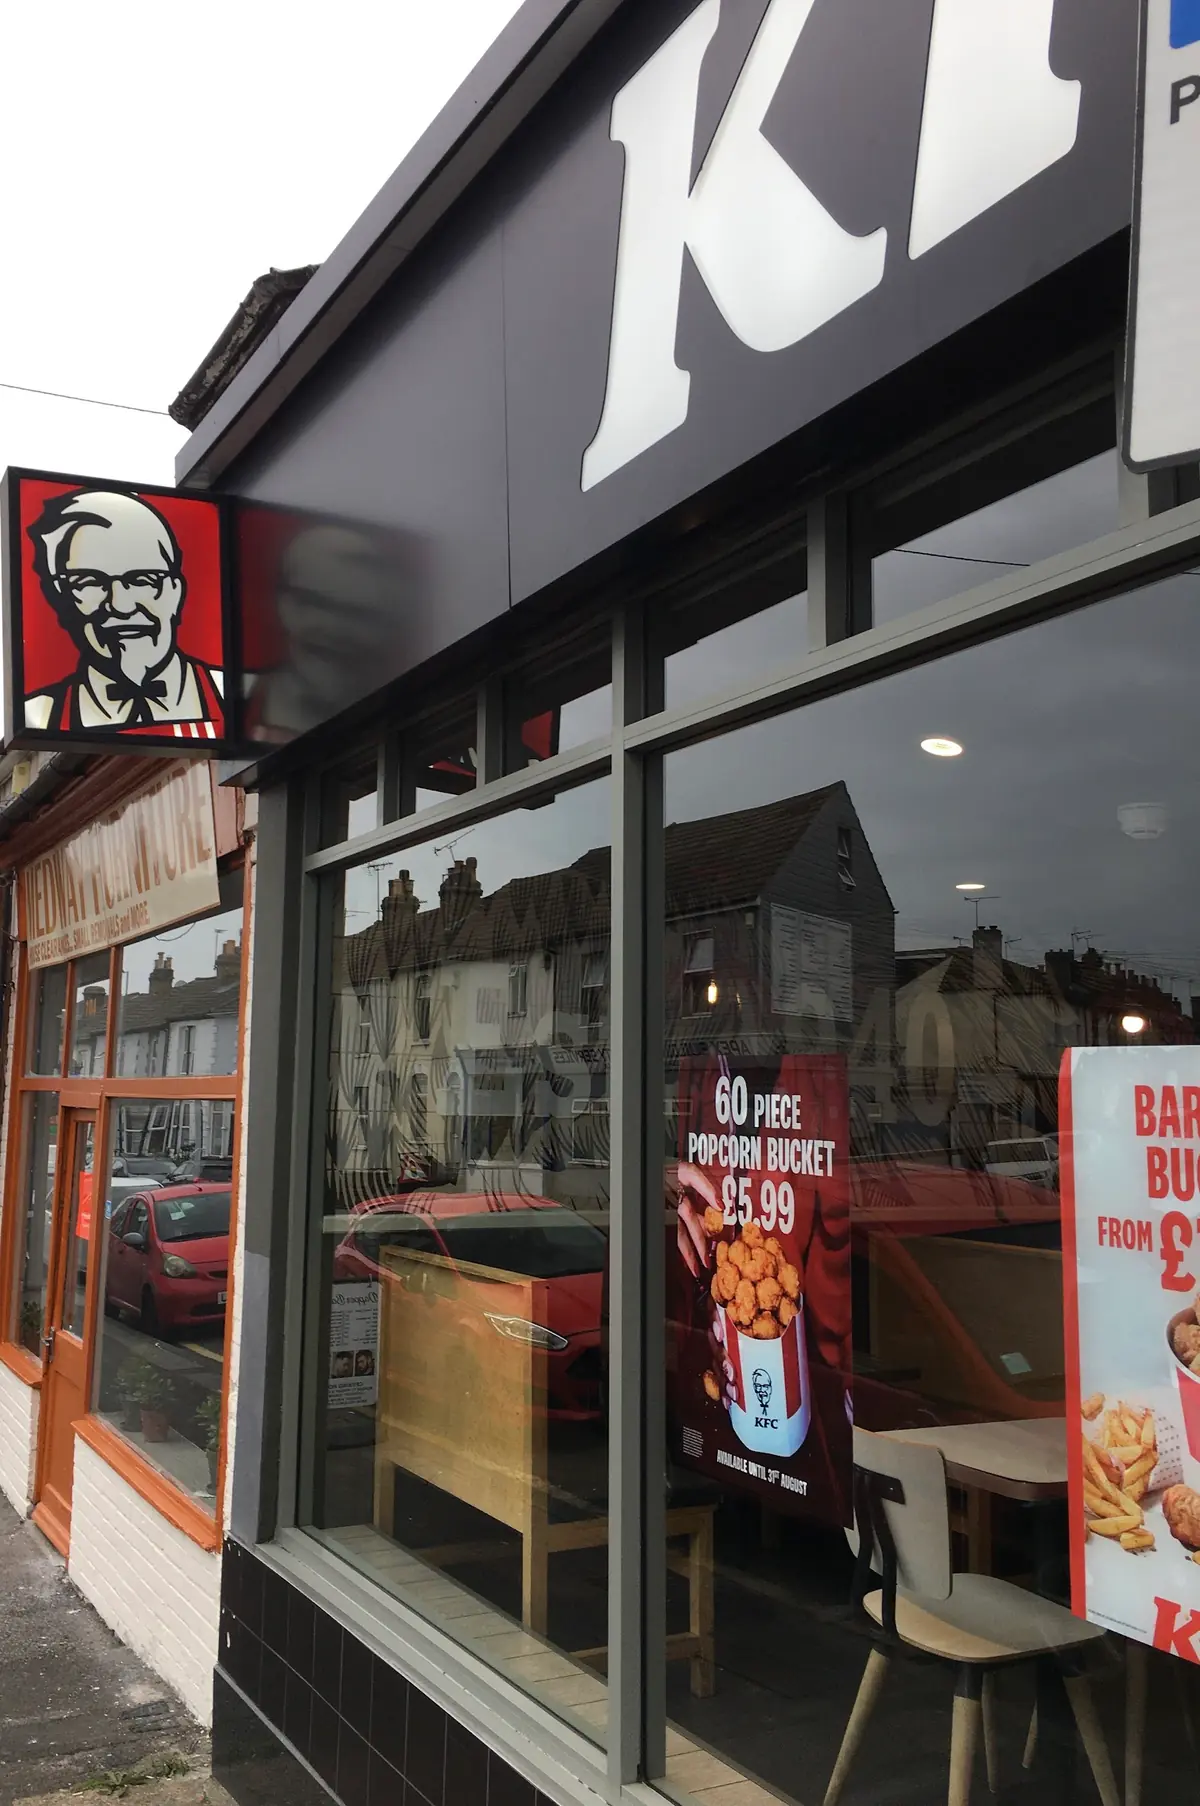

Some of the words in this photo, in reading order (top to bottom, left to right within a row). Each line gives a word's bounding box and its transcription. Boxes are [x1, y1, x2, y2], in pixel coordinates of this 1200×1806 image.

[715, 1075, 748, 1126] 60
[754, 1094, 802, 1130] PIECE
[688, 1132, 762, 1171] POPCORN
[767, 1136, 836, 1177] BUCKET
[1146, 1146, 1200, 1201] BU
[722, 1174, 796, 1235] £5.99
[1098, 1216, 1153, 1252] FROM
[755, 1417, 779, 1430] KFC
[716, 1449, 748, 1474] AVAILABLE
[748, 1460, 767, 1481] UNTIL
[780, 1473, 808, 1496] AUGUST
